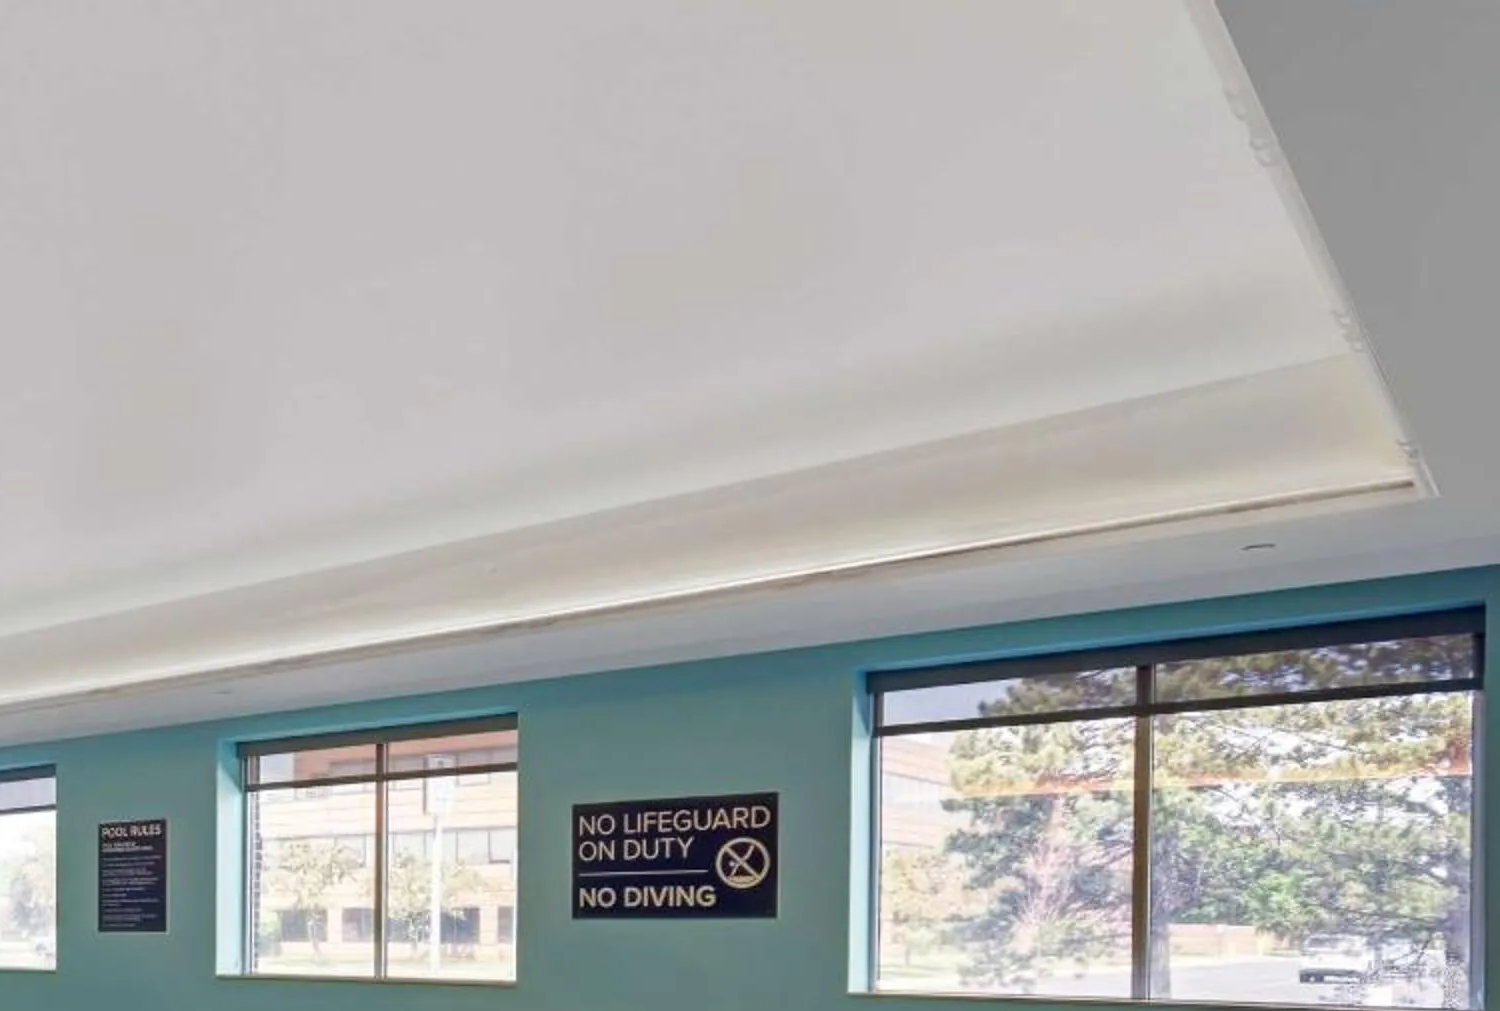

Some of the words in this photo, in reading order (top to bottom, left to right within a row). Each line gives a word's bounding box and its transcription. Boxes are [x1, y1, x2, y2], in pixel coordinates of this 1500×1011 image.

[102, 827, 129, 839] POOL
[130, 824, 161, 837] RULES
[579, 814, 616, 836] NO
[624, 805, 771, 834] LIFEGUARD
[579, 840, 615, 862] ON
[623, 836, 695, 861] DUTY
[579, 887, 616, 908] NO
[623, 885, 717, 908] DIVING
